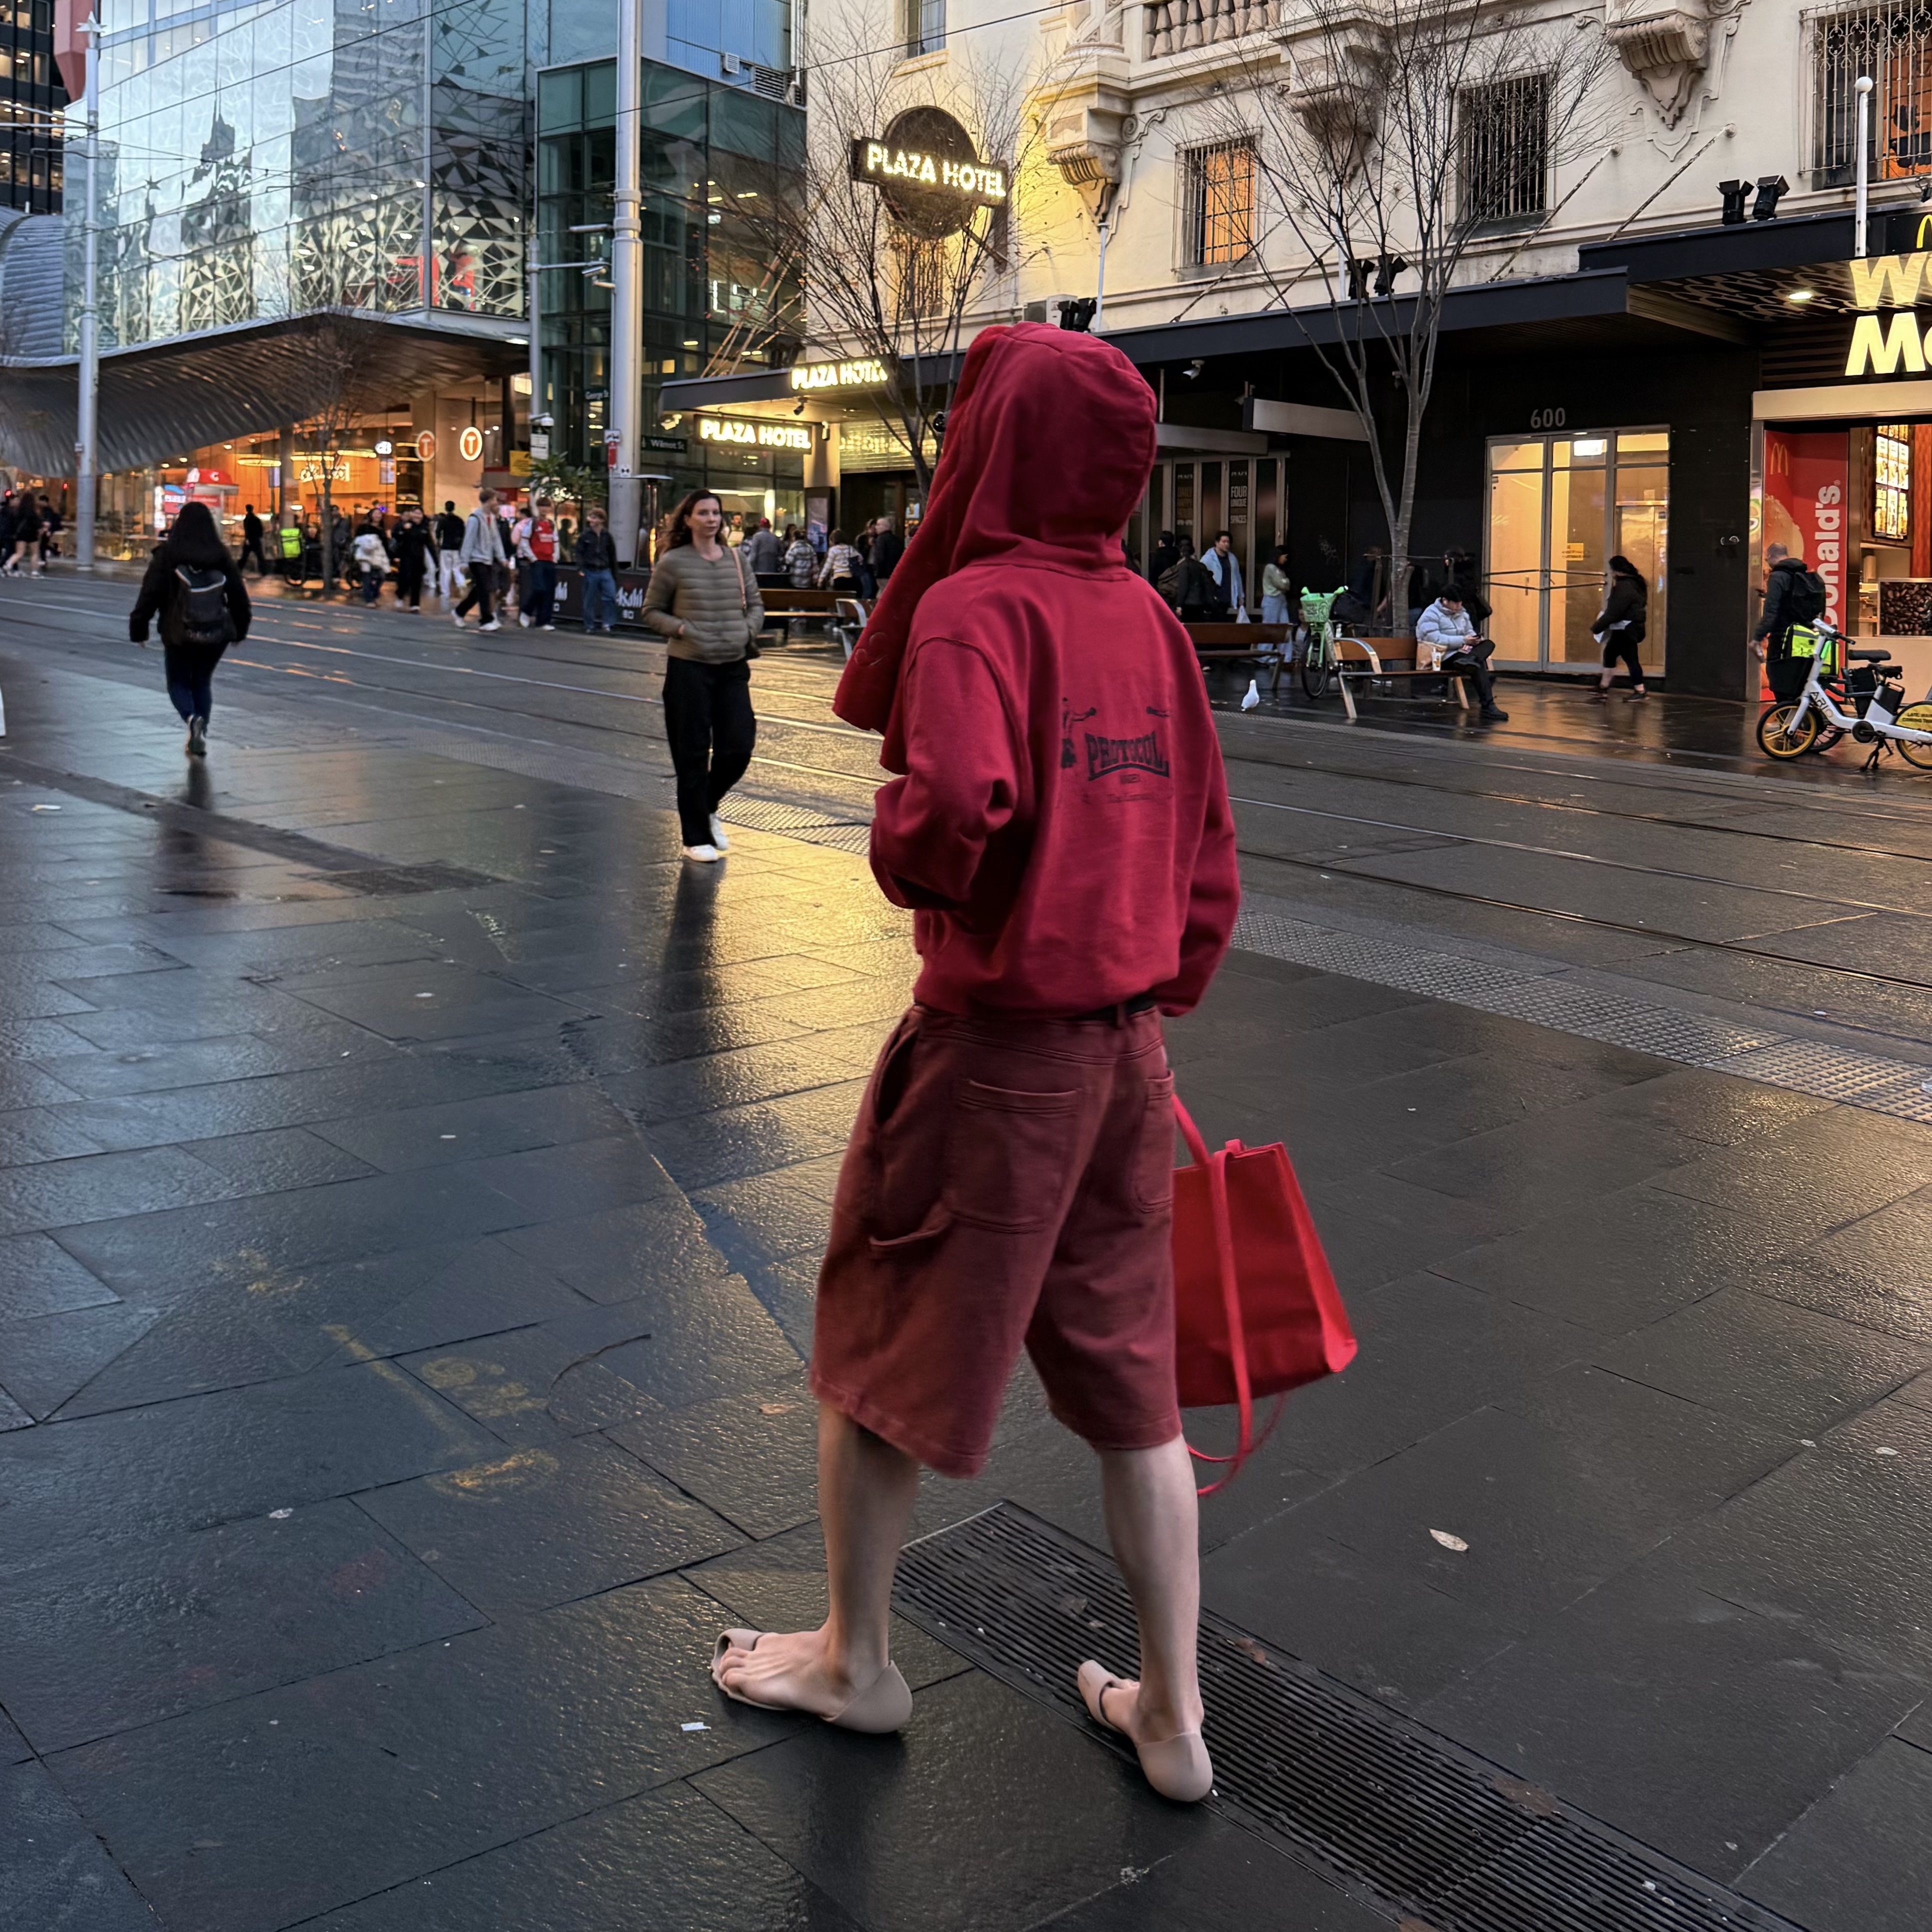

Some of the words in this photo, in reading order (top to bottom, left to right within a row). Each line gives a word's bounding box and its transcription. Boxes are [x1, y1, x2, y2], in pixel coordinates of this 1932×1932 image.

[868, 143, 936, 183] PLAZA
[943, 159, 1006, 197] HOTEL
[792, 364, 838, 390] PLAZA
[840, 359, 888, 385] HOTEL
[1530, 407, 1566, 428] 600
[700, 419, 756, 444] PLAZA
[758, 425, 812, 449] HOTEL
[1230, 486, 1248, 498] FOUR
[1810, 692, 1834, 718] ARIO
